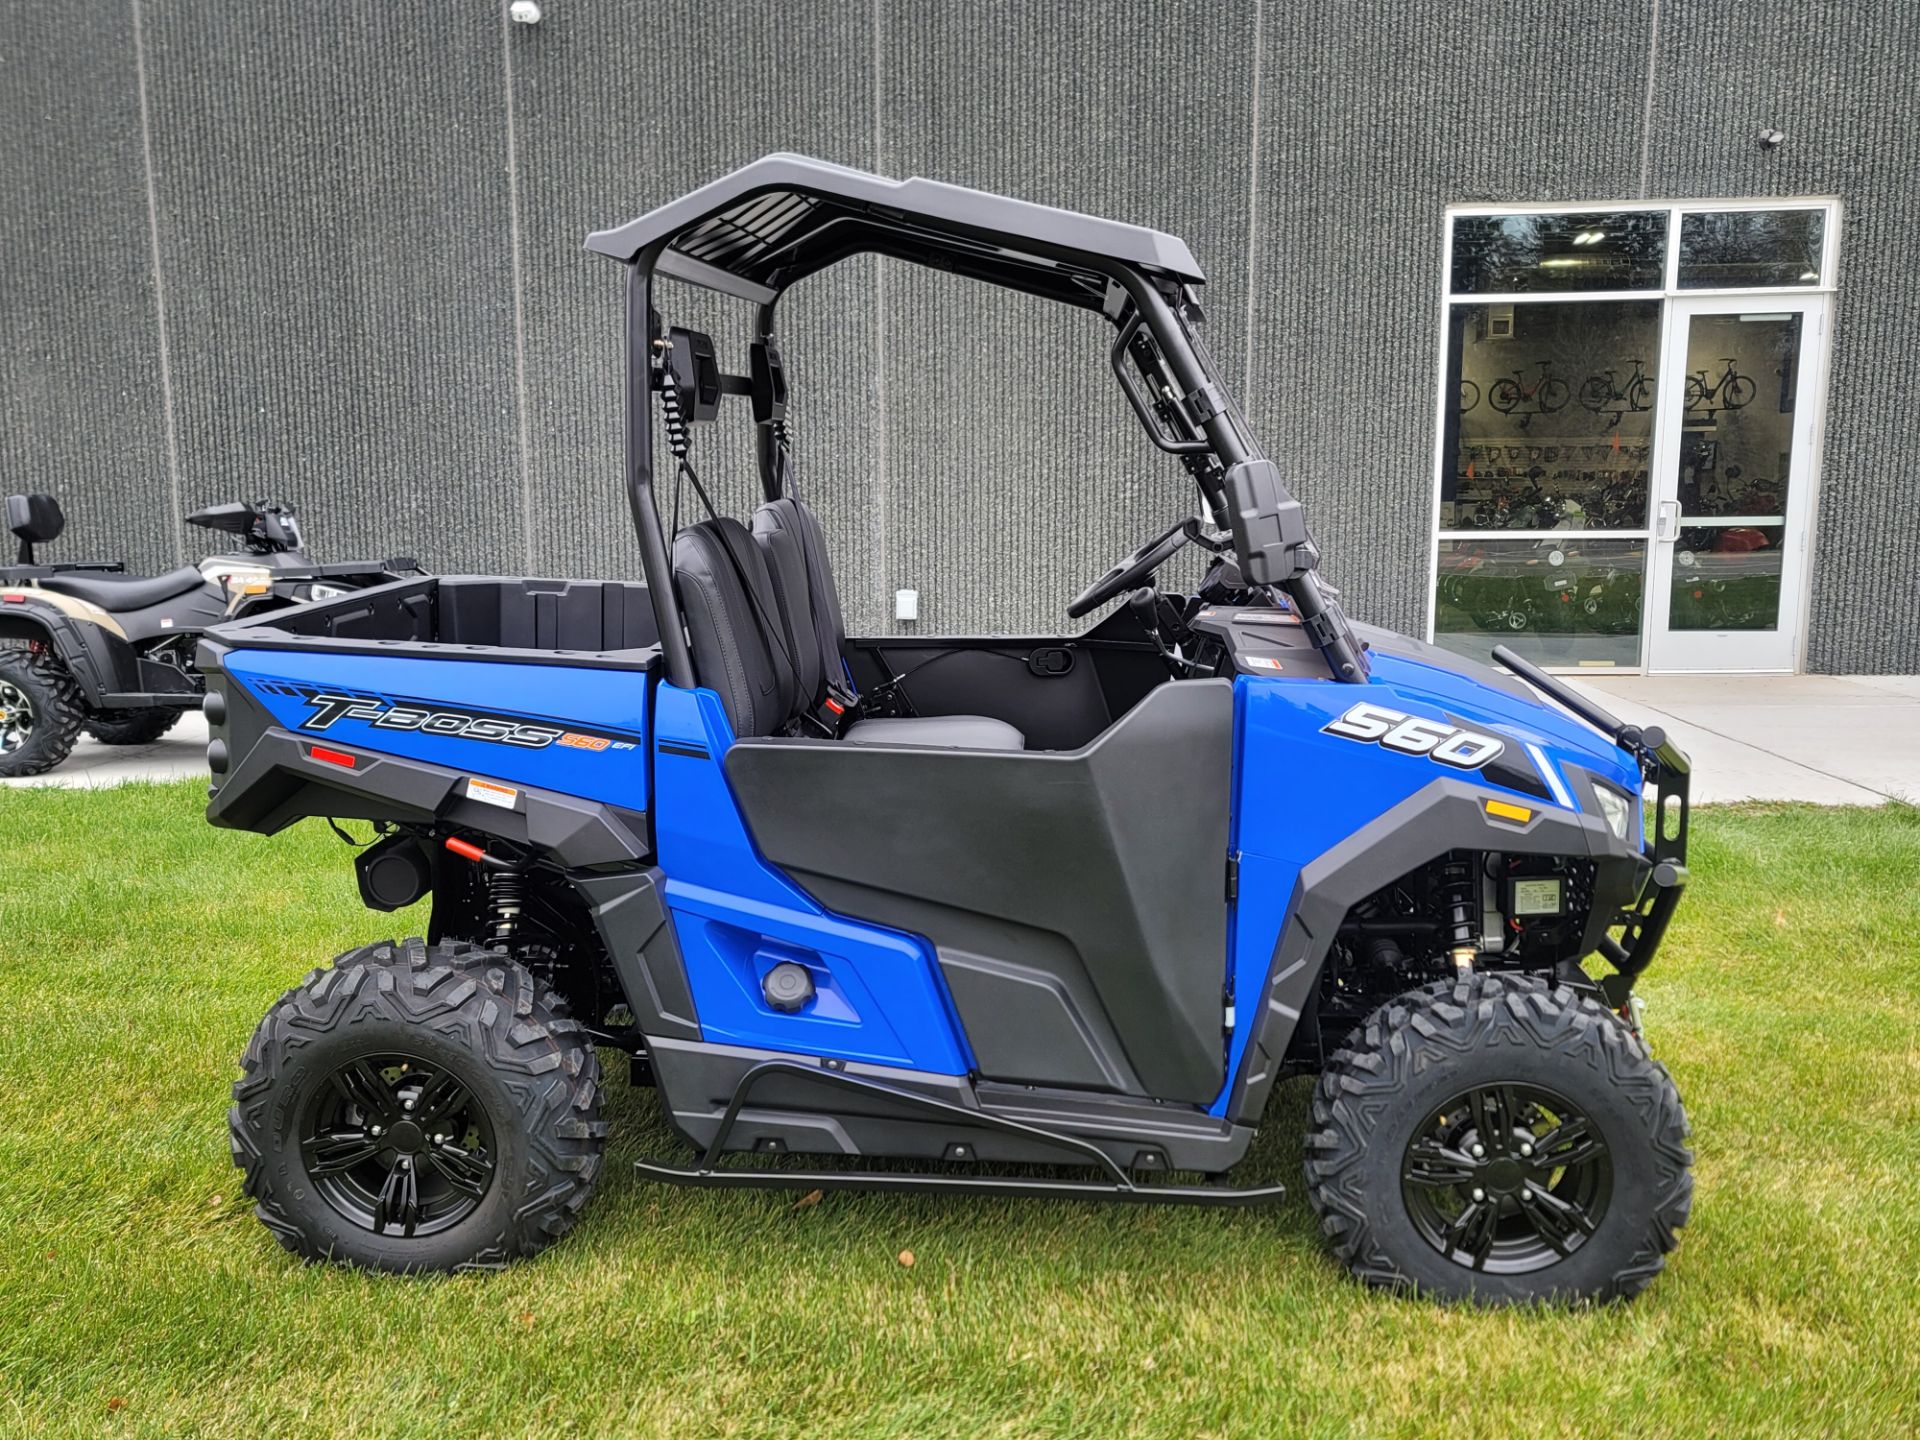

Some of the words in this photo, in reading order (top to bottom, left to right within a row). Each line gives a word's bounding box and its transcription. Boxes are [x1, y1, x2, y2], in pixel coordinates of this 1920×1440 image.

[304, 693, 564, 748] T-BOSS
[556, 733, 612, 752] 560
[611, 741, 639, 751] EFI
[1319, 701, 1505, 772] 560
